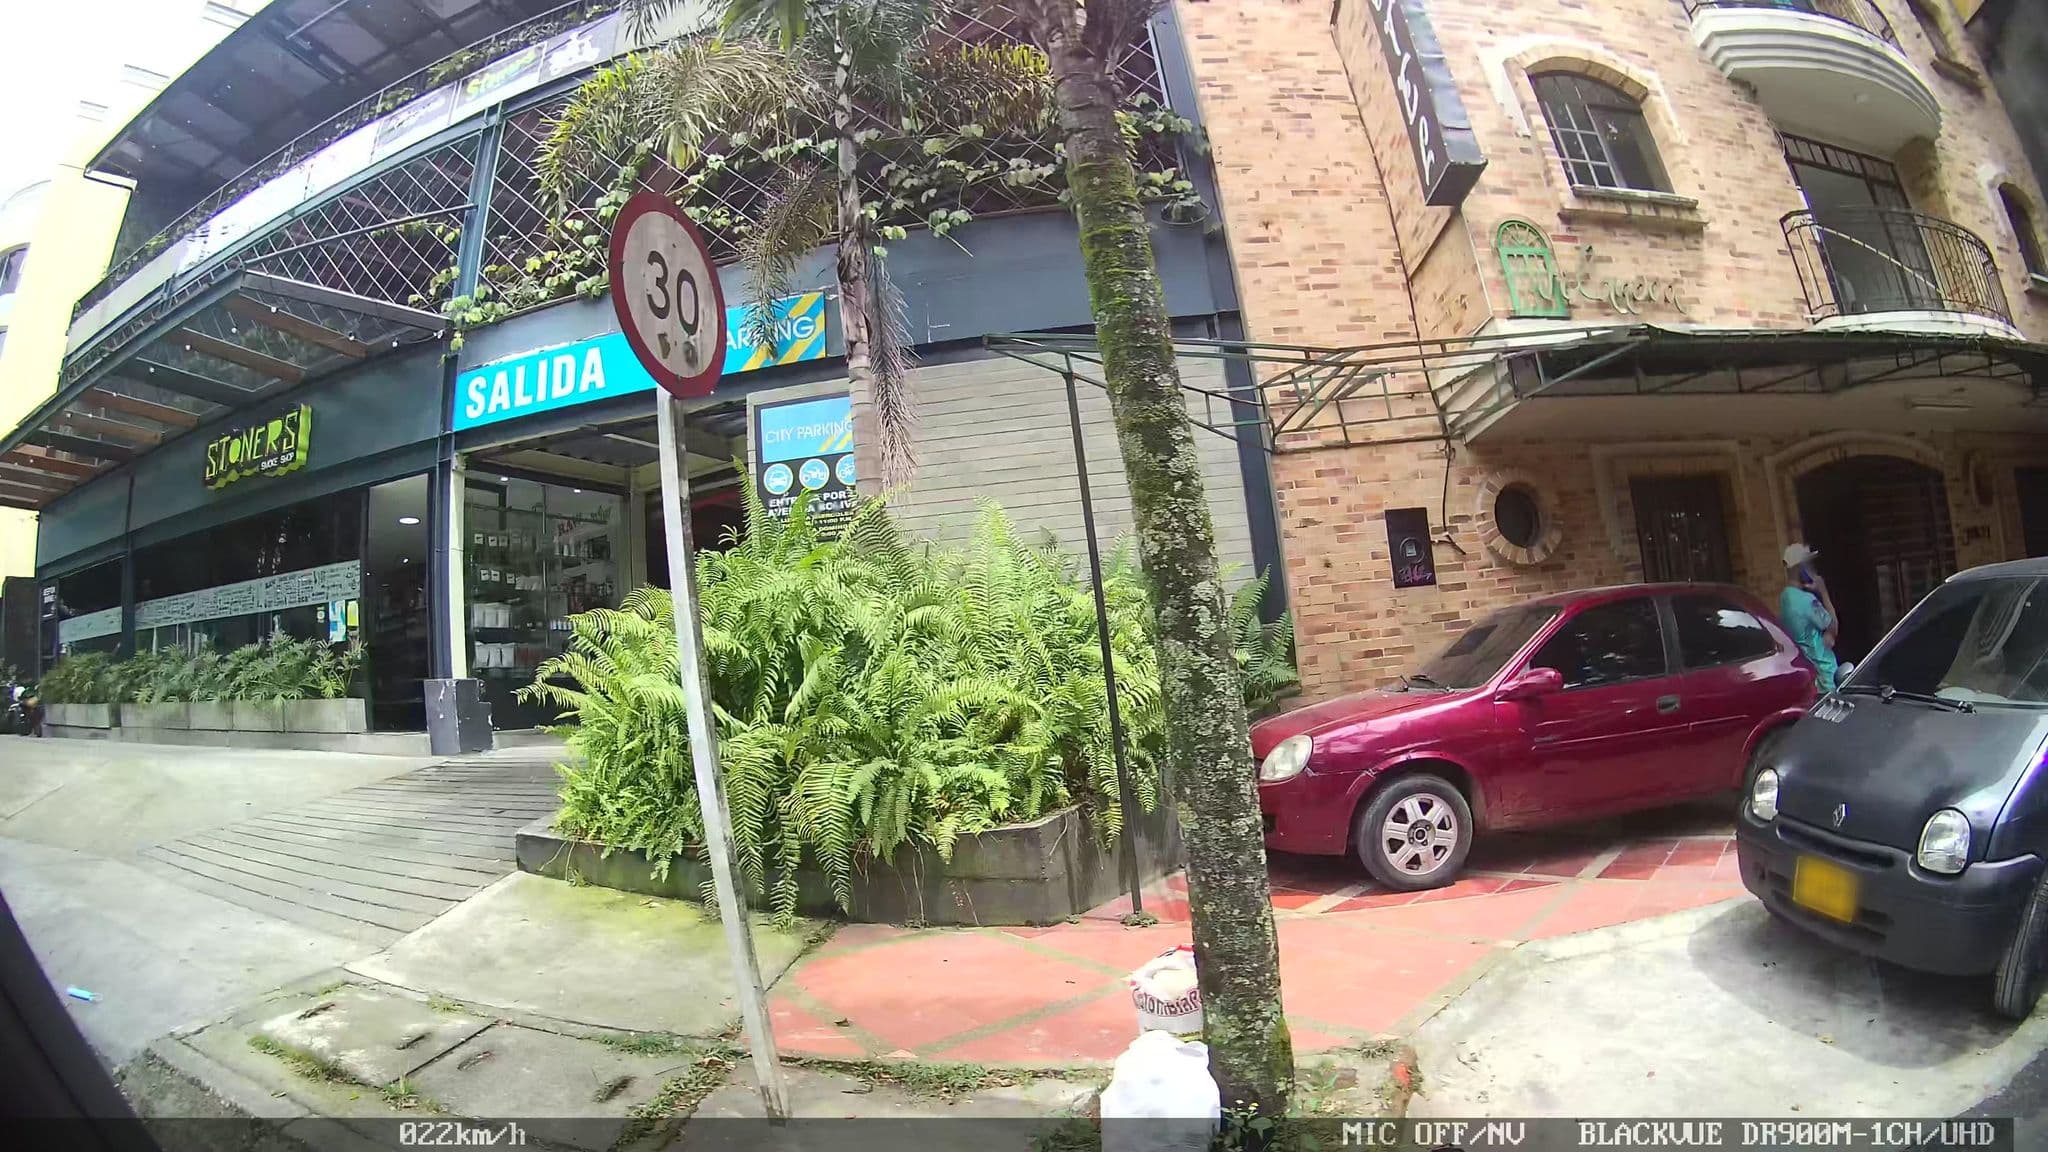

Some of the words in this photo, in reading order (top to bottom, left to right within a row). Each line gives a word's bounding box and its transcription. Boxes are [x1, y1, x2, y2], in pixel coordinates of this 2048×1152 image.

[647, 250, 699, 336] 30
[466, 347, 606, 419] SALIDA
[823, 491, 847, 500] POR
